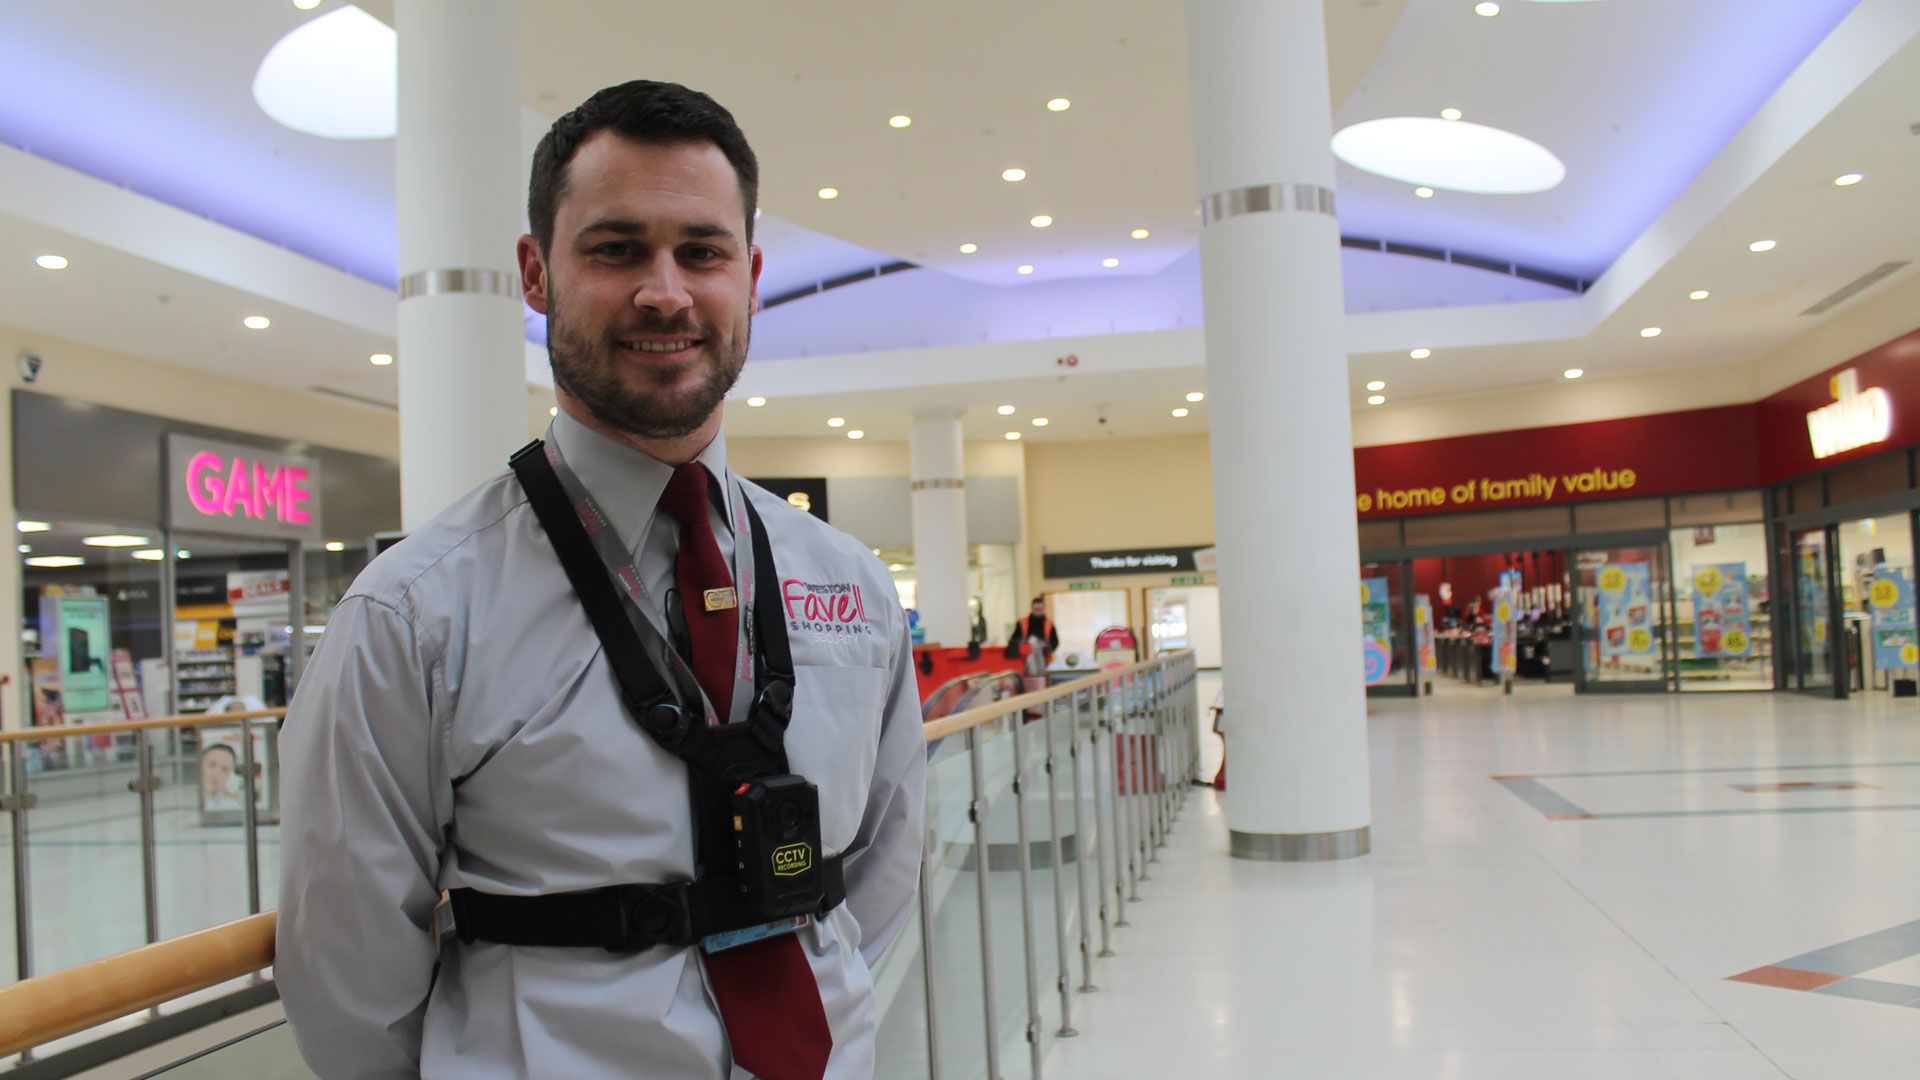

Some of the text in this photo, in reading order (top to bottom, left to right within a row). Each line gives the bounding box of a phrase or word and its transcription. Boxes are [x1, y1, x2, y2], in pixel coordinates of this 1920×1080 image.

[186, 450, 311, 524] GAME
[1376, 487, 1447, 511] home
[1451, 479, 1477, 504] of
[1480, 472, 1558, 501] family
[1562, 467, 1637, 494] value
[1126, 555, 1141, 567] for
[805, 582, 851, 594] WESTON
[783, 579, 868, 624] Favell
[776, 848, 805, 865] CCTV
[777, 860, 807, 871] RECORDING
